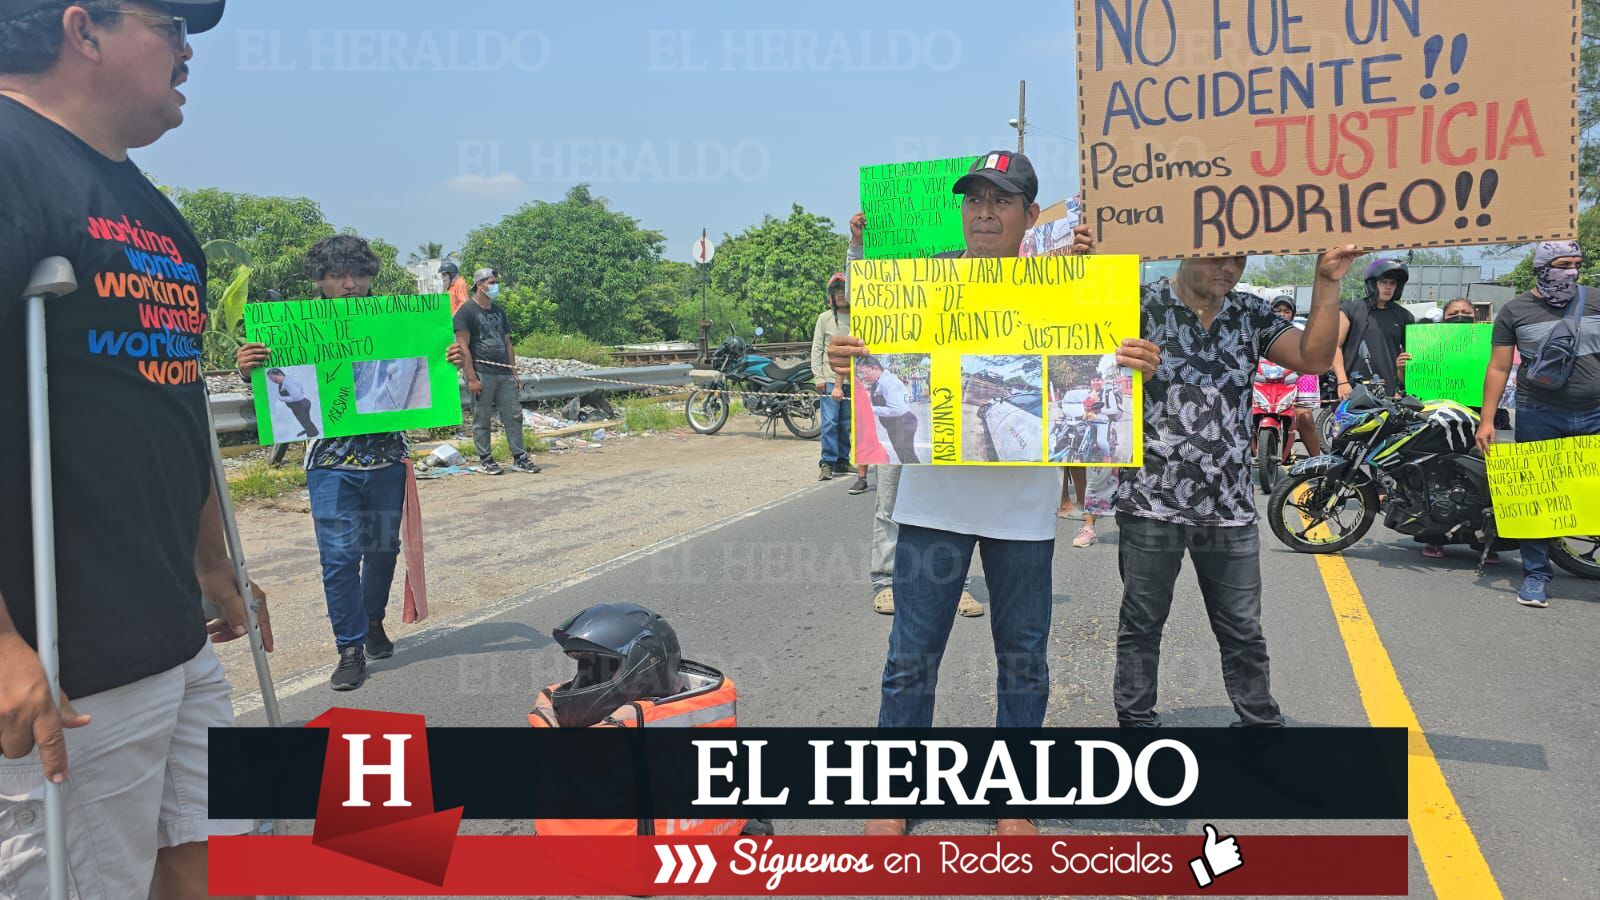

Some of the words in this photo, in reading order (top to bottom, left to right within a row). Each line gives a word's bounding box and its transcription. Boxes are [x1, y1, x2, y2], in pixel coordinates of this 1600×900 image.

[1096, 0, 1177, 71] NO
[1215, 0, 1311, 59] FUE
[1346, 0, 1420, 45] UN
[1090, 142, 1232, 190] Pedimos
[1250, 97, 1544, 180] JUSTICIA
[1096, 202, 1163, 243] para
[87, 214, 182, 264] working
[124, 246, 202, 286] women
[913, 259, 960, 283] LIDIA
[968, 258, 1003, 284] LARA
[94, 272, 200, 312] working
[300, 301, 338, 320] LIDIA
[334, 320, 353, 341] DE
[314, 336, 374, 364] JACINTO
[138, 359, 198, 385] wom
[1554, 439, 1566, 451] DE
[1537, 453, 1561, 469] VIVE
[1488, 470, 1535, 485] NUESTRA
[1541, 465, 1574, 481] LUCHA
[1545, 494, 1572, 512] PARA
